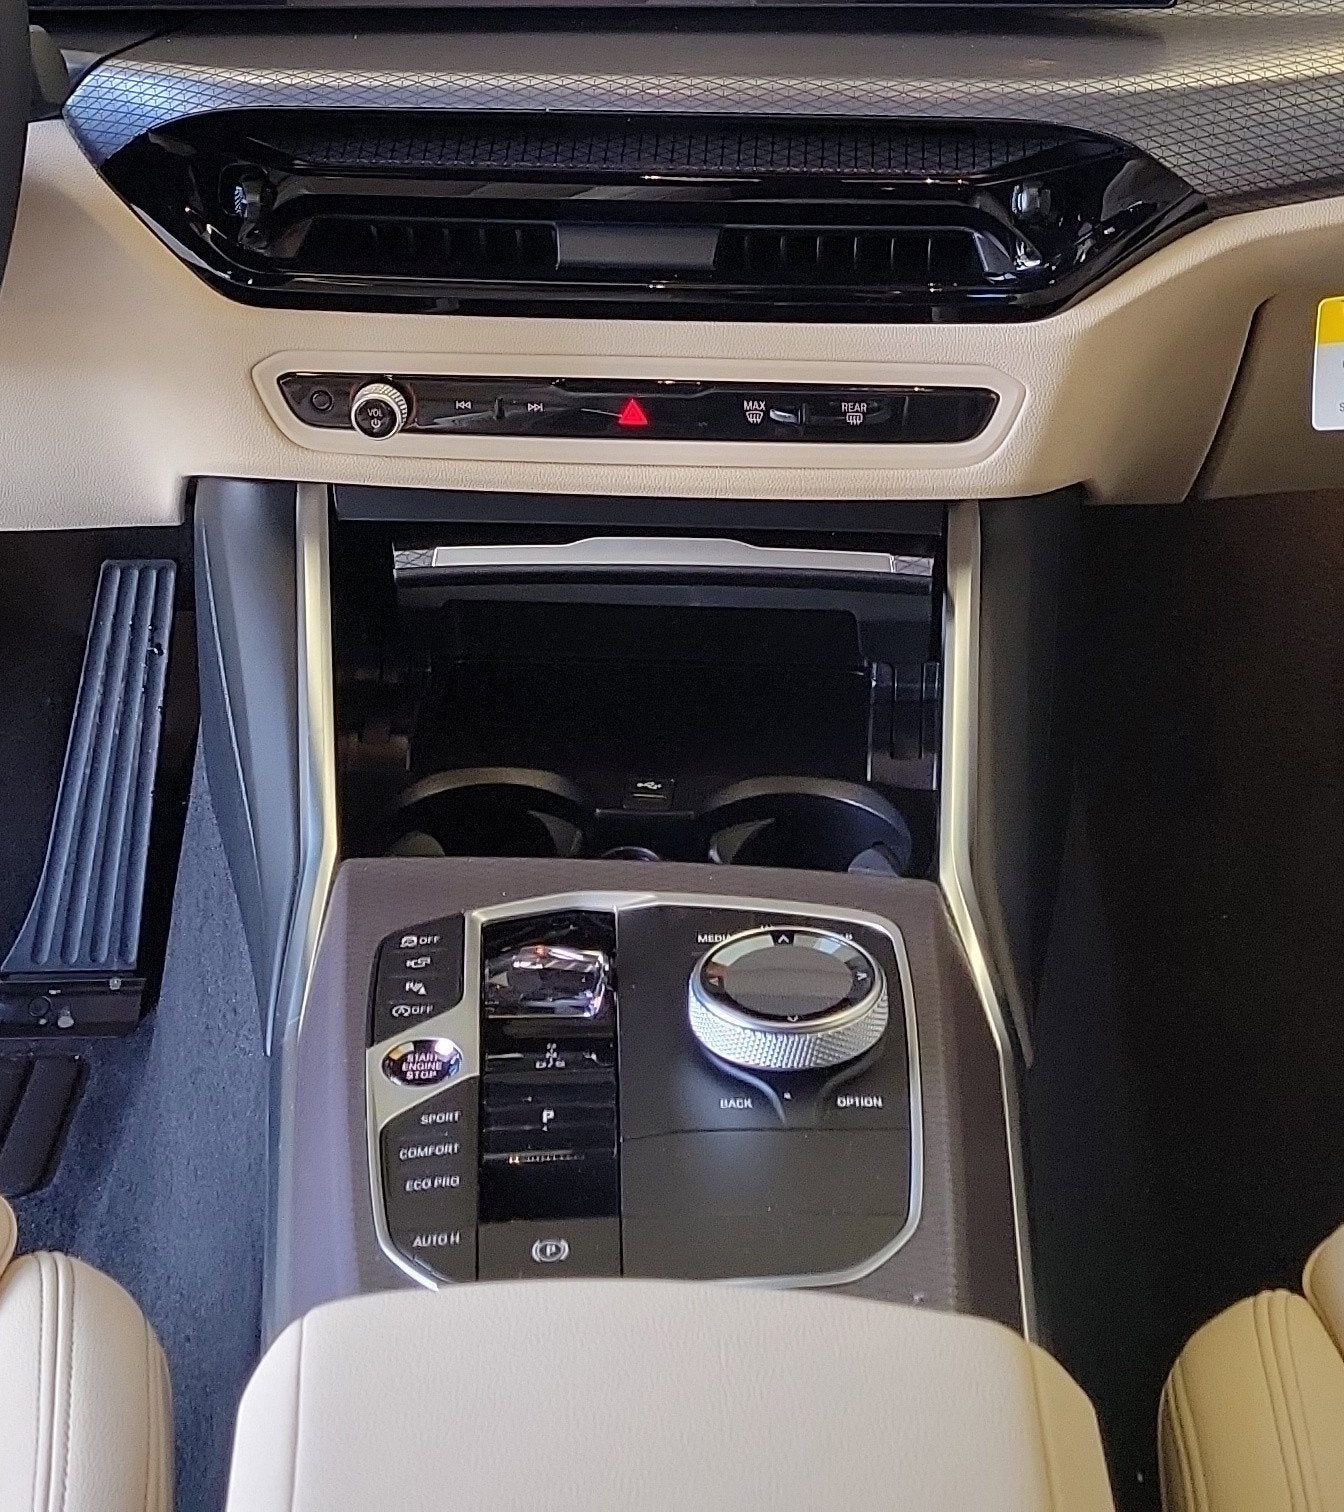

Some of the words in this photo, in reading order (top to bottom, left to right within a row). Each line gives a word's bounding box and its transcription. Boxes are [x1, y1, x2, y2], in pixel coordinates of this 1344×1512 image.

[743, 400, 766, 411] MAX
[841, 402, 868, 413] REAR
[367, 408, 383, 417] VOL
[401, 1061, 442, 1071] ENGINE
[406, 1070, 437, 1080] STOP
[719, 1098, 753, 1109] BACK
[836, 1096, 883, 1108] OPTION
[420, 1111, 461, 1125] SPORT
[542, 1108, 555, 1124] P
[399, 1143, 460, 1161] COMFORT
[405, 1177, 432, 1192] ECO
[433, 1175, 460, 1188] PRO
[412, 1234, 448, 1248] AUTO
[450, 1231, 460, 1245] H
